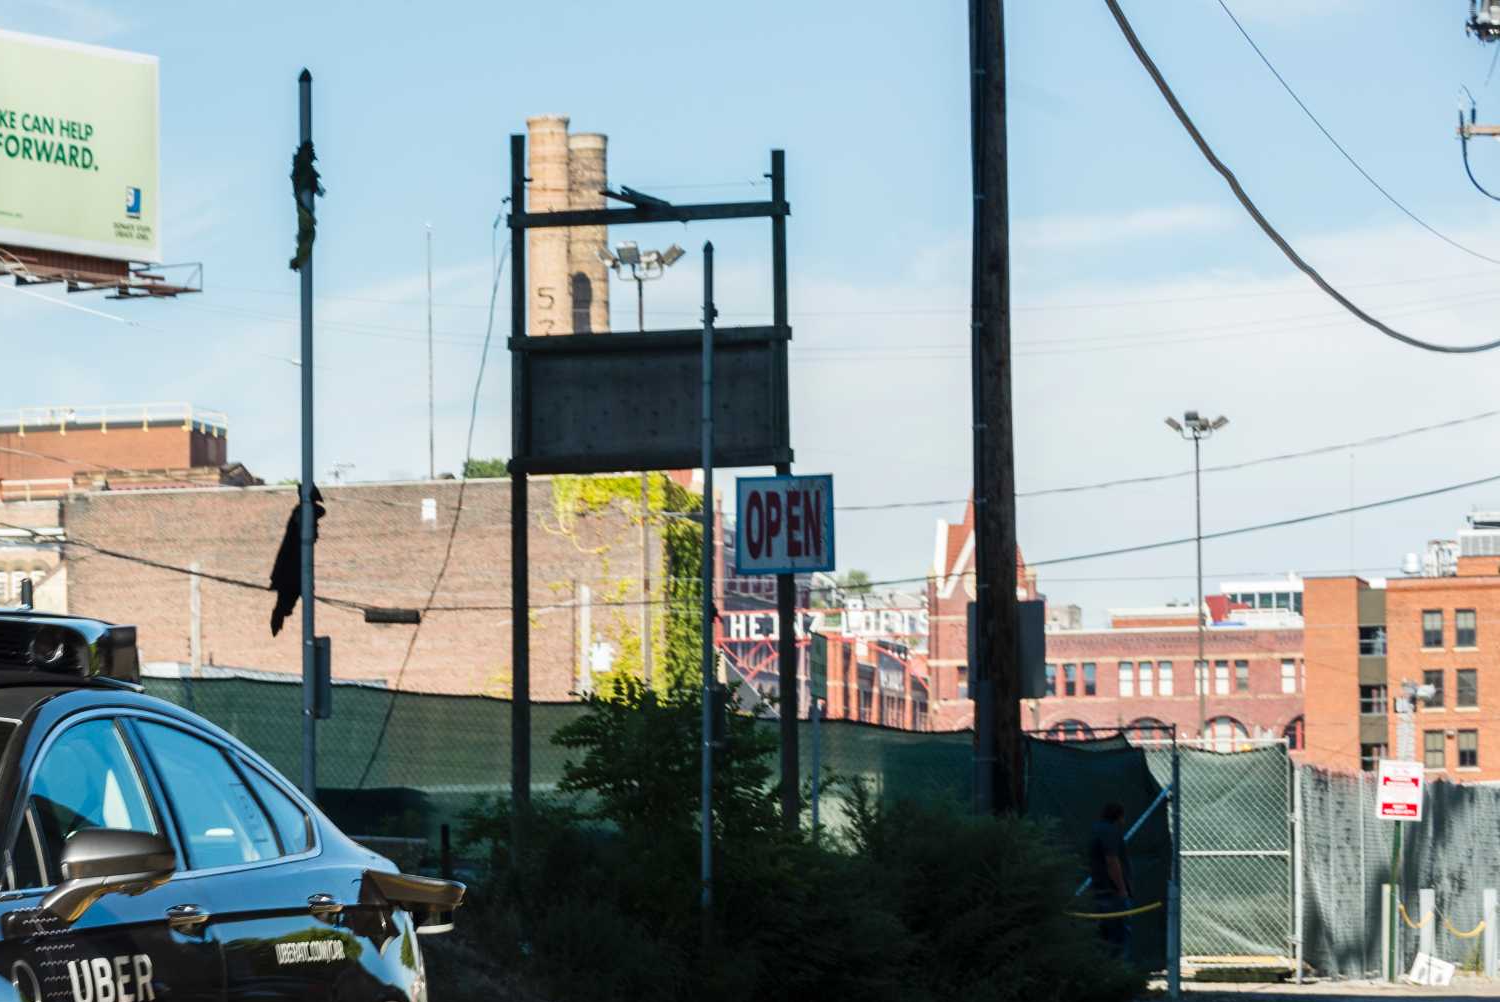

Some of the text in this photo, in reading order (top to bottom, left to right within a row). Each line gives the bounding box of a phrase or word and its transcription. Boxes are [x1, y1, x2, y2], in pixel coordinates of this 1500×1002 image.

[21, 113, 54, 135] CAN
[59, 120, 94, 142] HELP
[745, 489, 821, 561] OPEN
